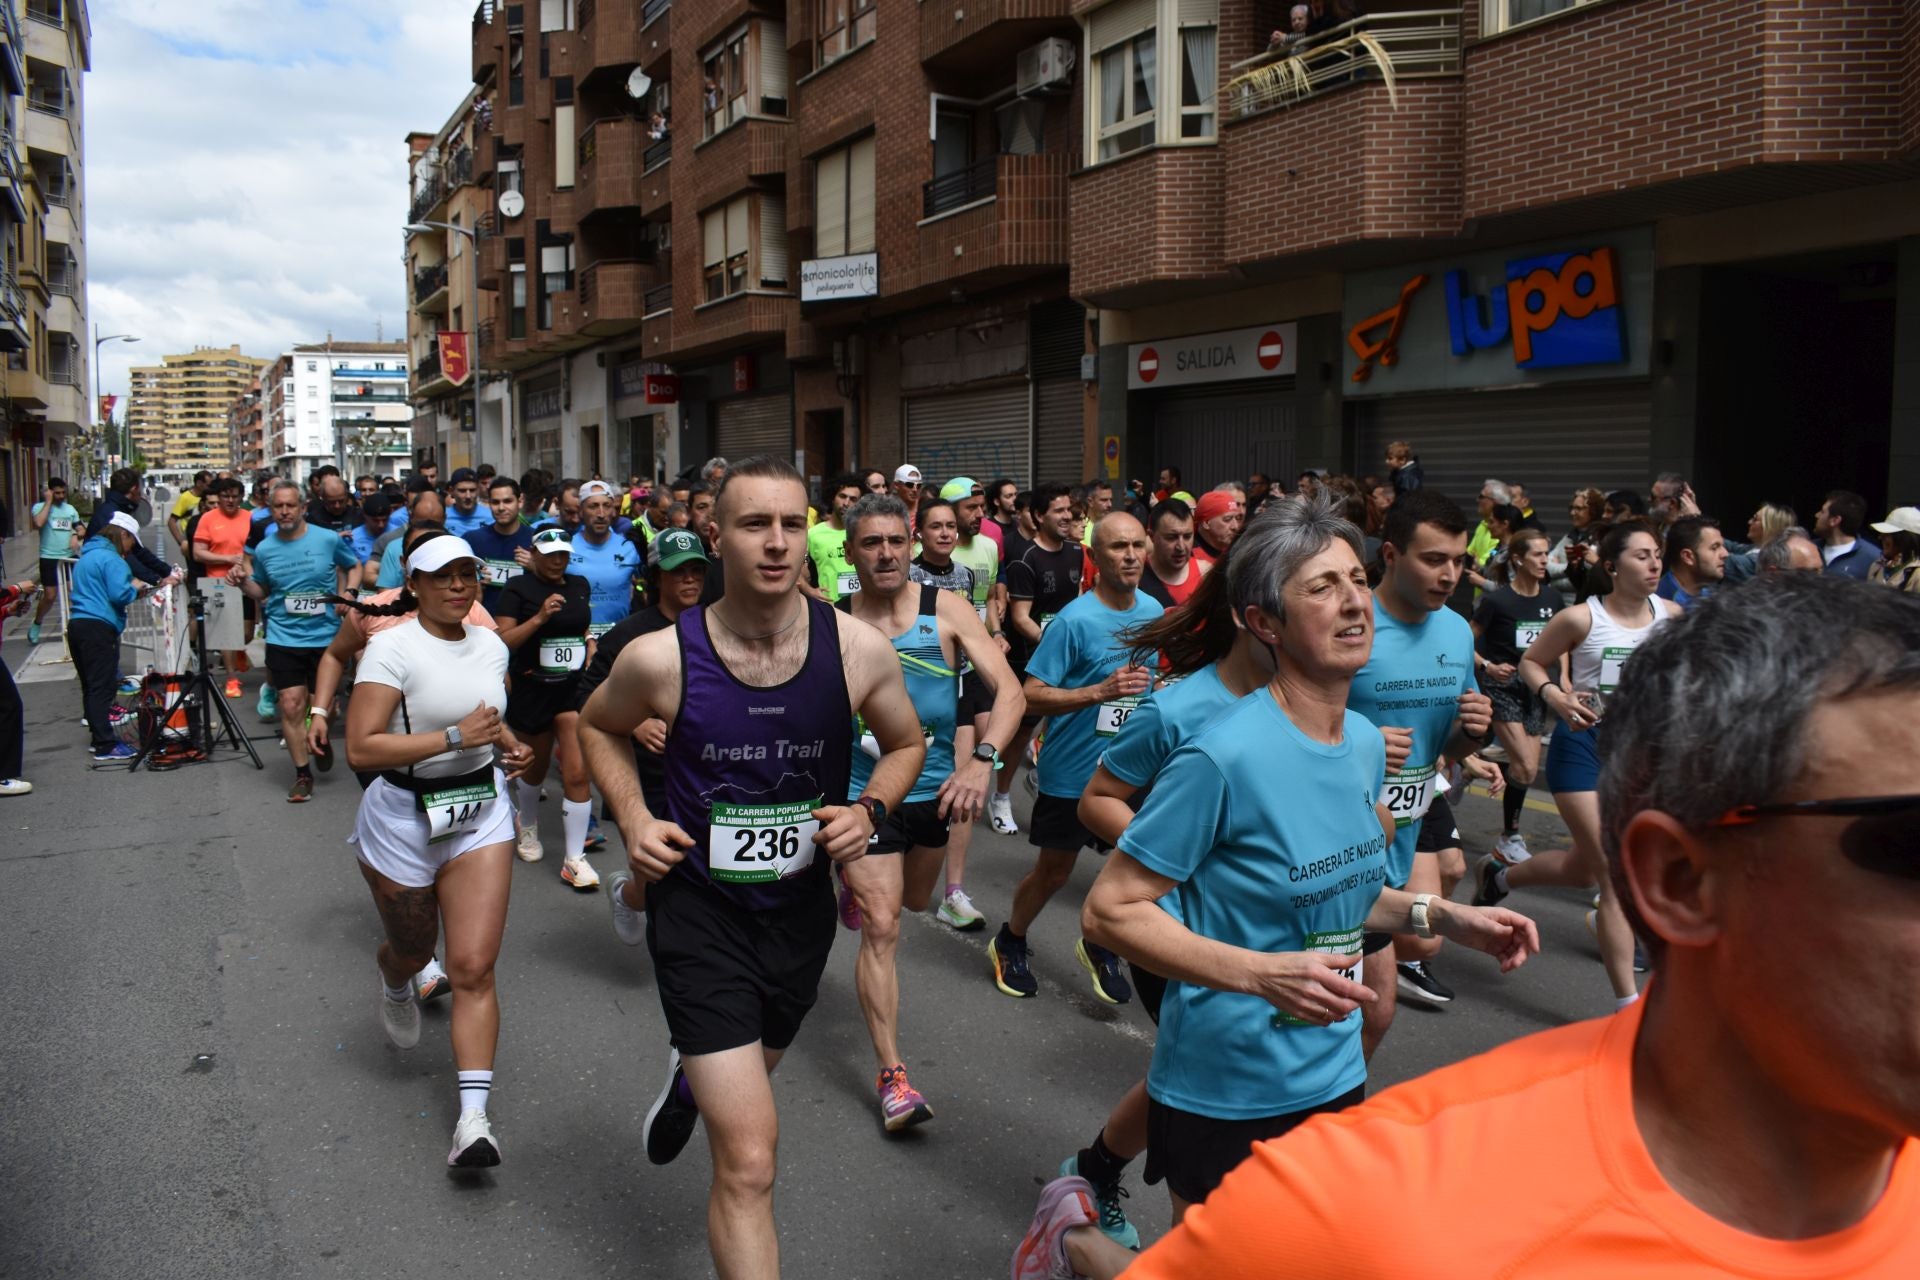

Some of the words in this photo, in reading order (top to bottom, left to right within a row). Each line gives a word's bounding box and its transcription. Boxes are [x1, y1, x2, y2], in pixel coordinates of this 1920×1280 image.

[1444, 247, 1617, 364] lupa
[1176, 345, 1236, 372] SALIDA
[496, 568, 509, 580] 71
[293, 599, 318, 611] 275
[555, 648, 572, 662] 80
[1375, 681, 1414, 692] CARRERA
[1415, 680, 1425, 689] DE
[1426, 676, 1457, 687] NAVIDAD
[701, 743, 767, 761] Areta
[775, 740, 824, 758] Trail
[1388, 782, 1426, 811] 291
[446, 801, 482, 828] 144
[726, 807, 737, 815] XV
[738, 807, 775, 816] CARRERA
[777, 804, 810, 815] POPULAR
[776, 816, 785, 824] DE
[785, 815, 793, 823] LA
[734, 826, 799, 862] 236
[1289, 853, 1343, 882] CARRERA
[1344, 847, 1355, 864] DE
[1357, 834, 1385, 860] NAVIDAD
[1361, 872, 1367, 886] Y
[1315, 936, 1325, 944] XV
[1324, 934, 1349, 943] CARRERA
